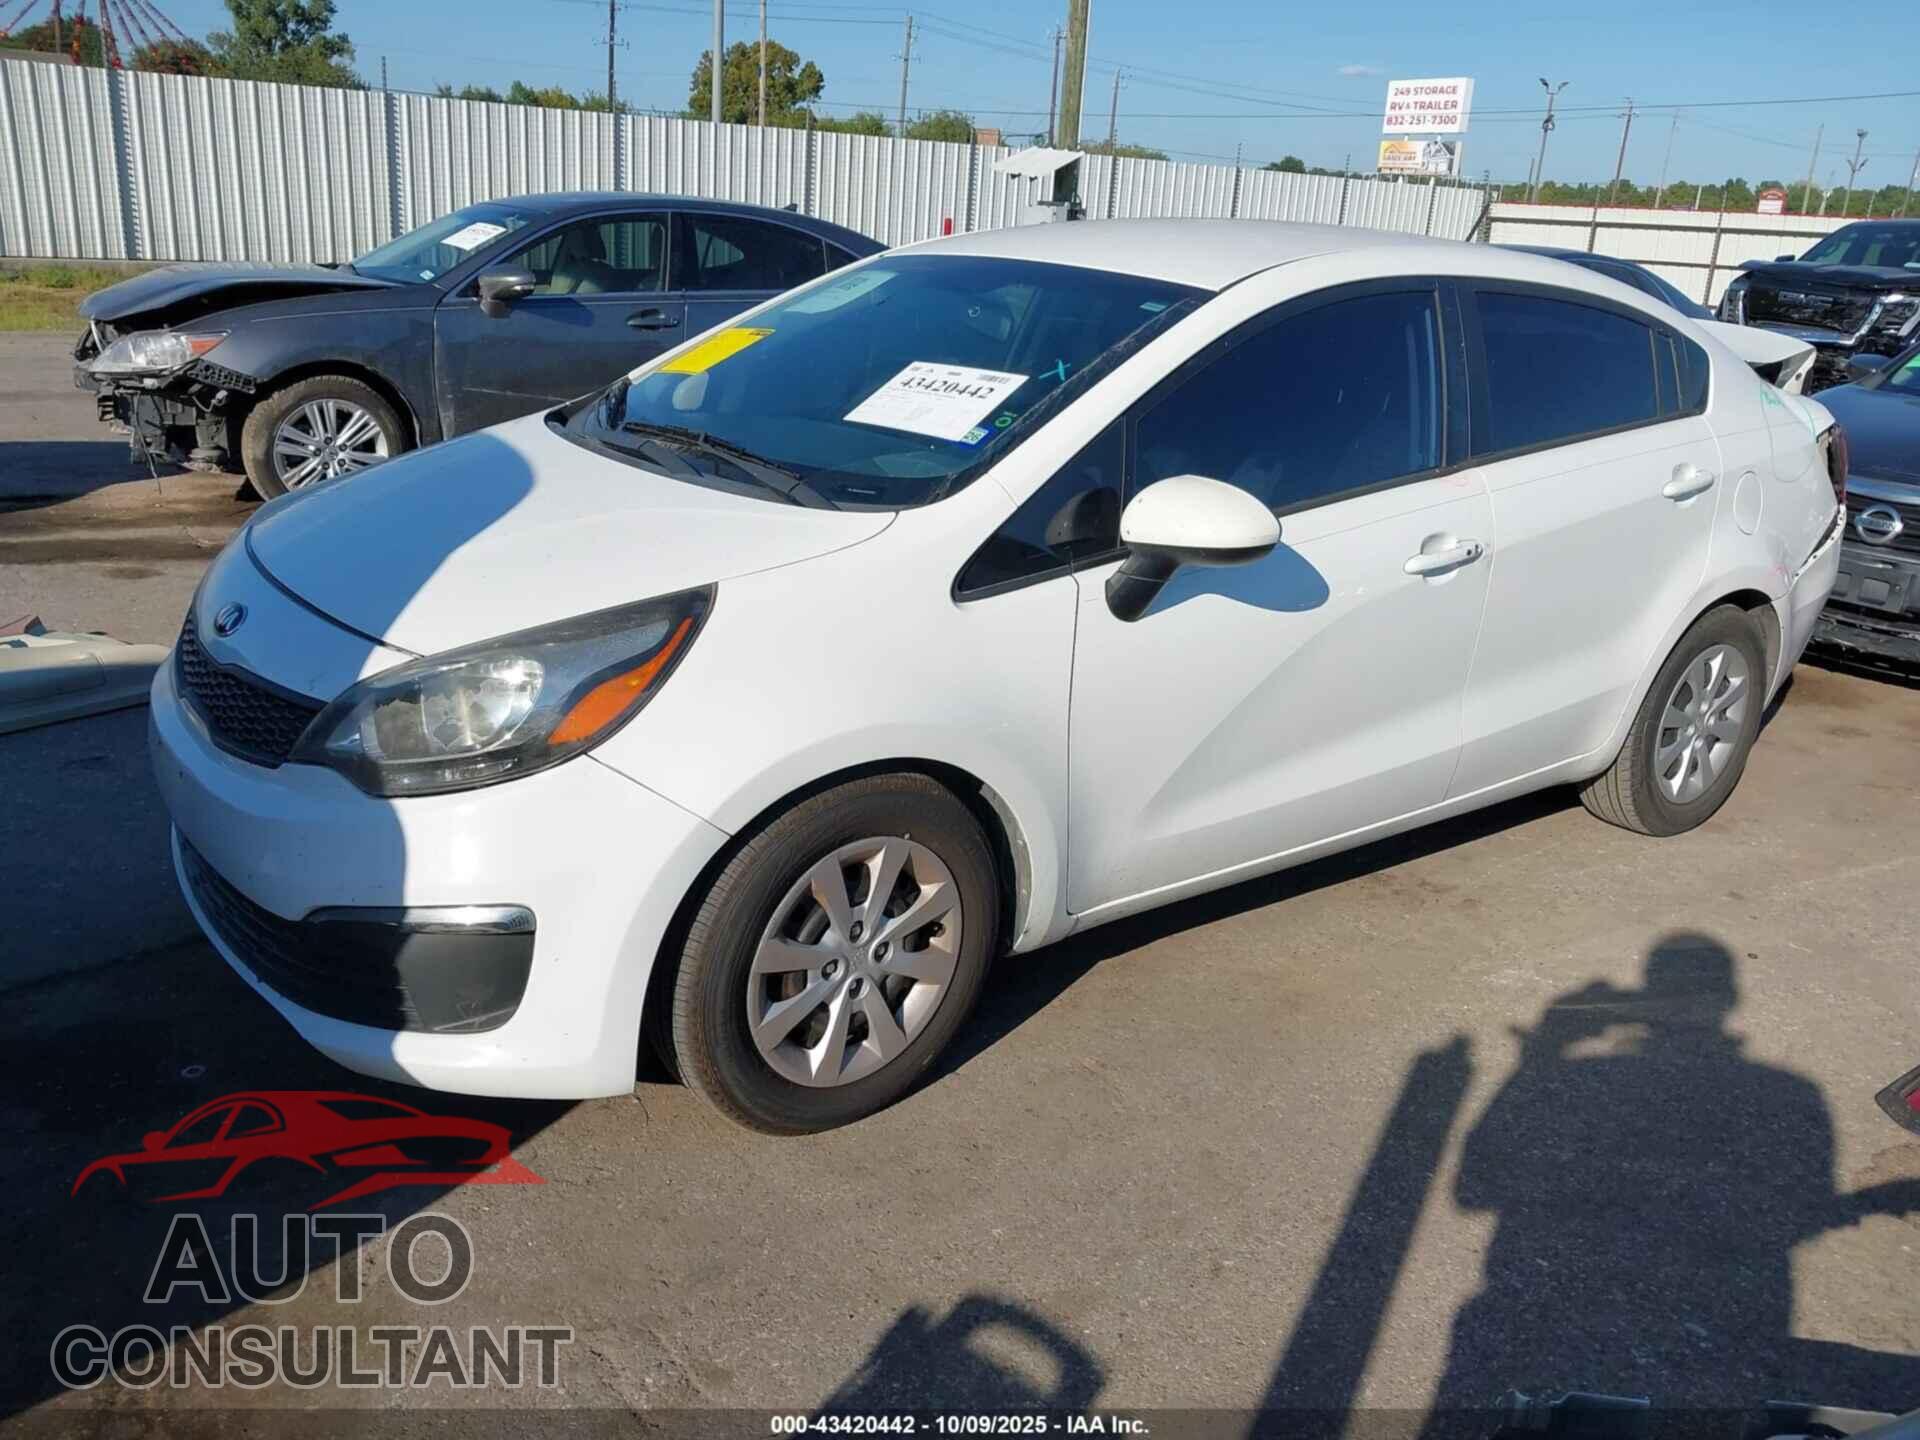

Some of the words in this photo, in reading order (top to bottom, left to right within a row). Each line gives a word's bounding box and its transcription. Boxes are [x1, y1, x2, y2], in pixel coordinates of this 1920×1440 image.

[1393, 87, 1411, 96] 249
[1413, 85, 1458, 95] STORAGE
[1390, 101, 1405, 111] RV
[1413, 100, 1458, 110] TRAILER
[1386, 115, 1457, 126] 832-251-7300
[900, 376, 995, 399] 43420442
